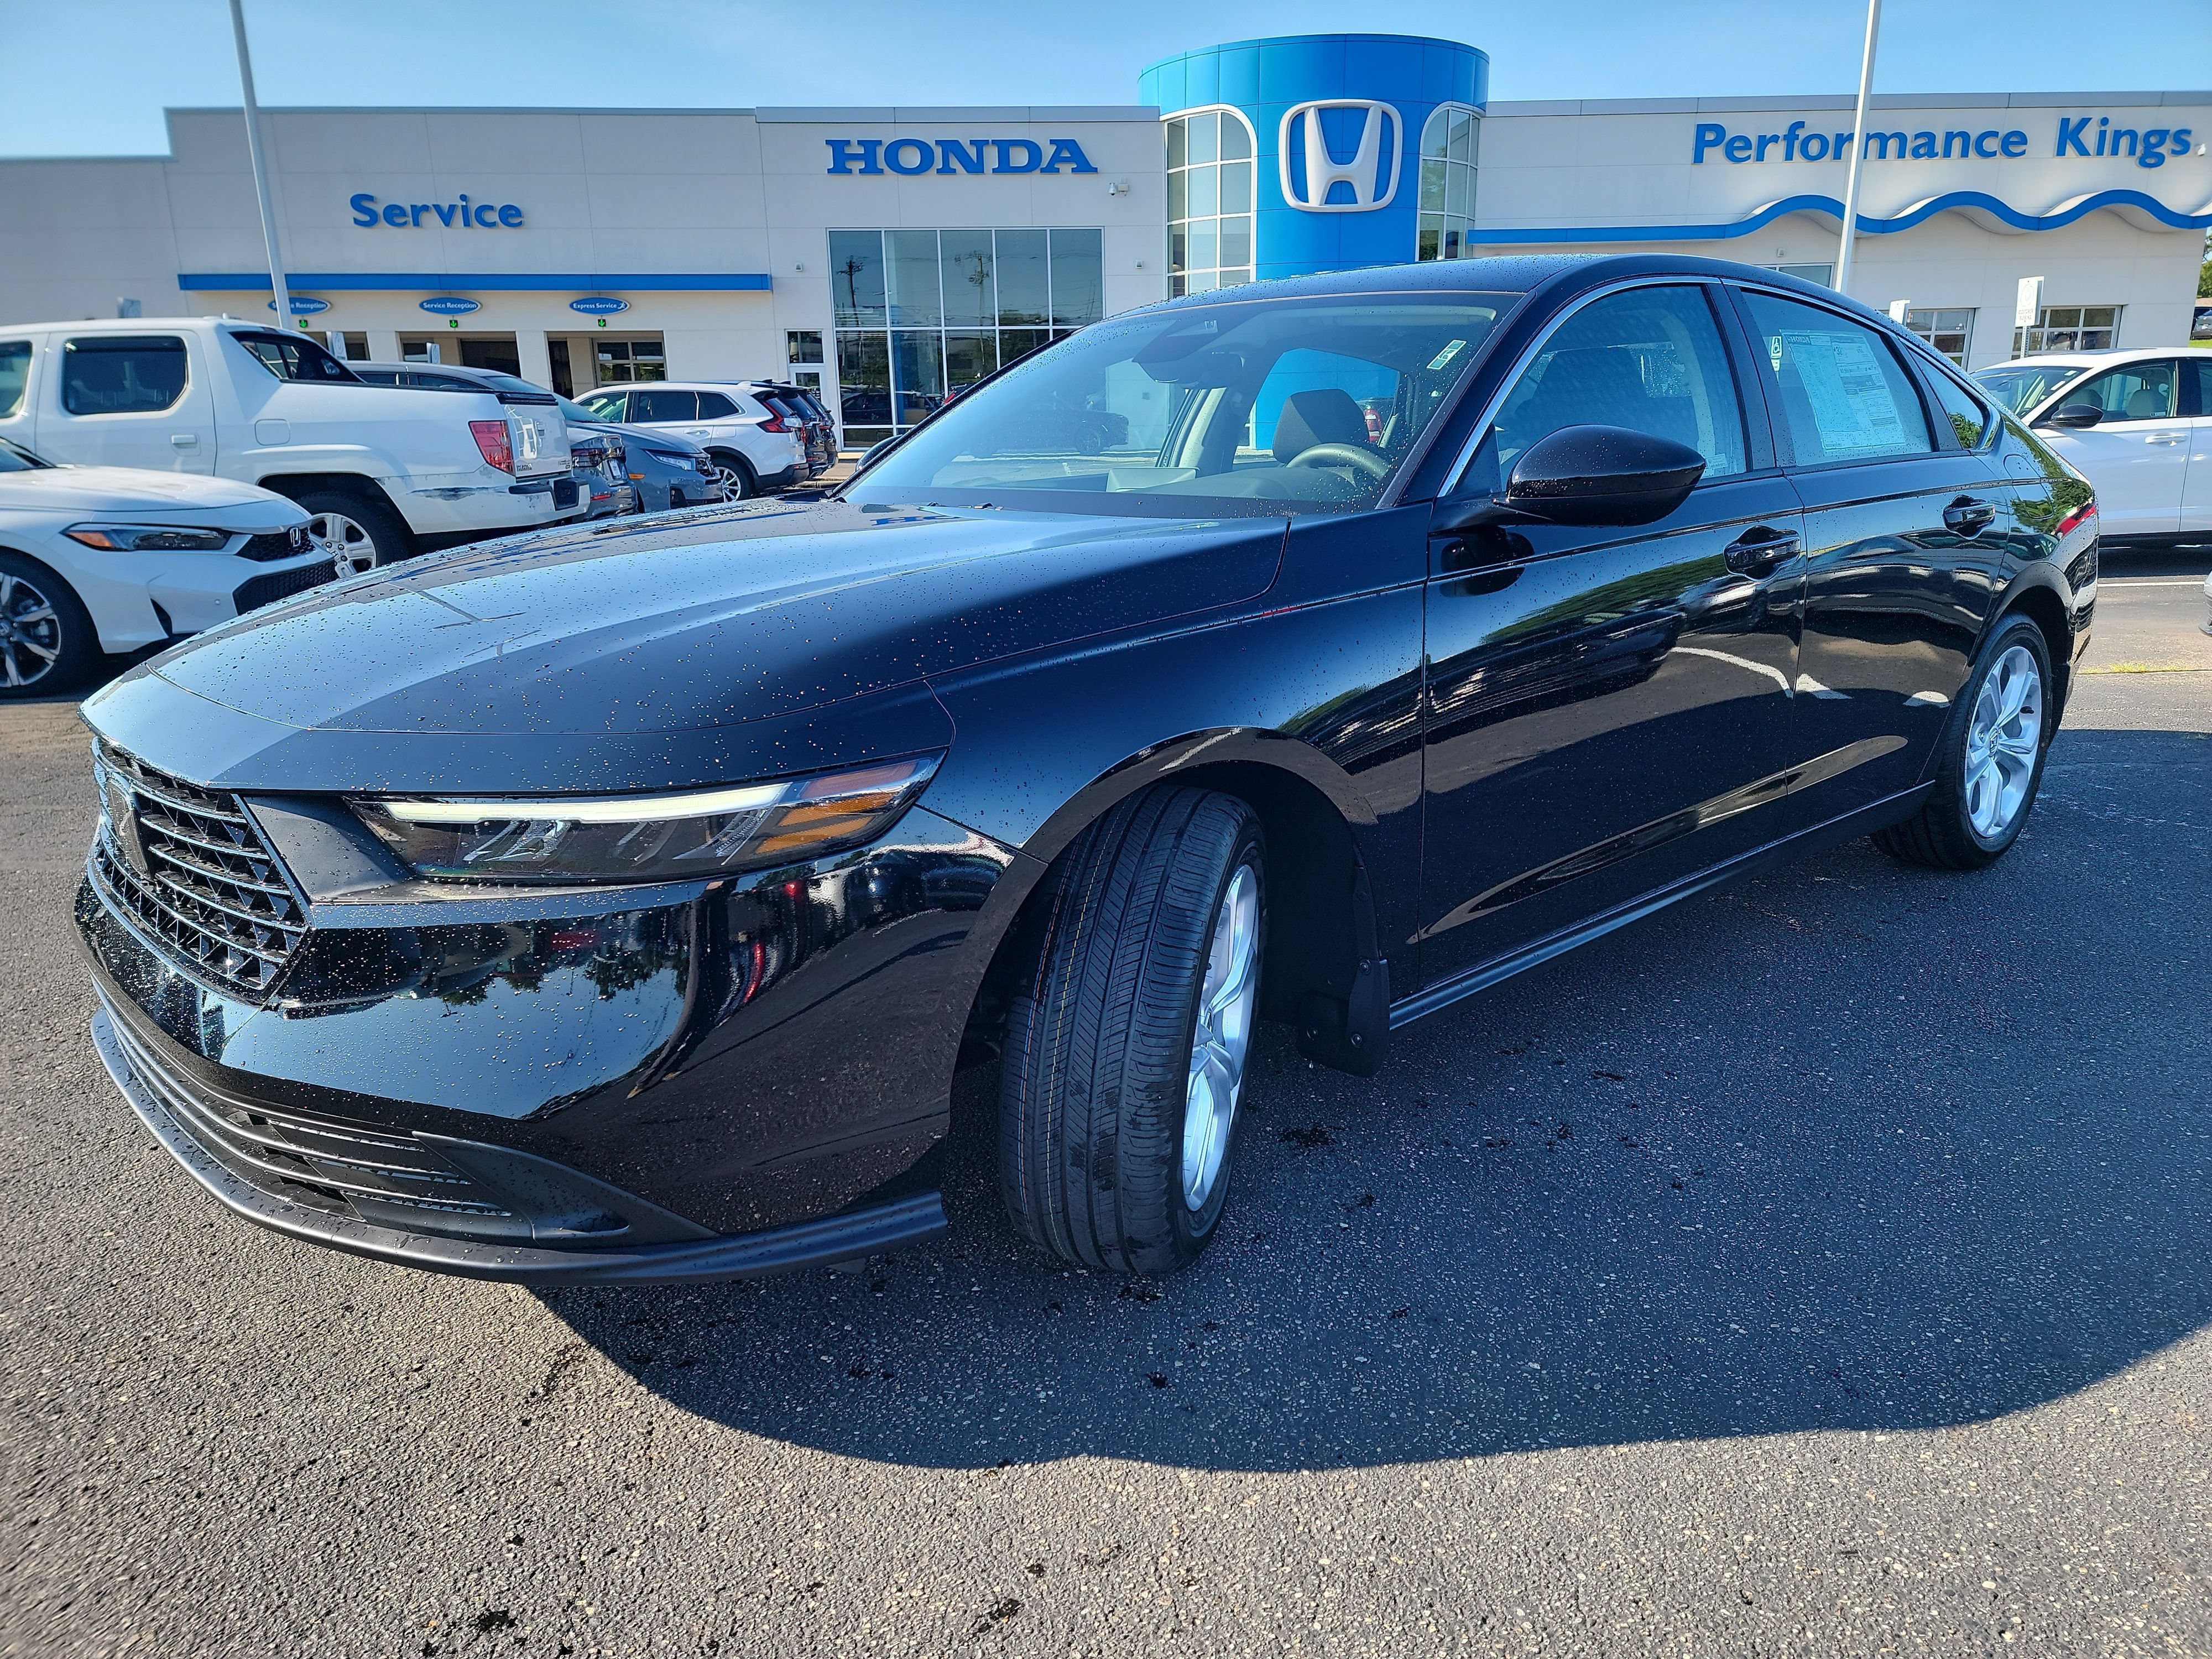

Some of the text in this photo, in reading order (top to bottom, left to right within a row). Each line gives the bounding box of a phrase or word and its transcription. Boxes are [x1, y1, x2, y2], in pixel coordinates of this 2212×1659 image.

[825, 138, 1098, 175] HONDA
[1693, 117, 2193, 168] Performance Kings
[349, 194, 523, 228] Service
